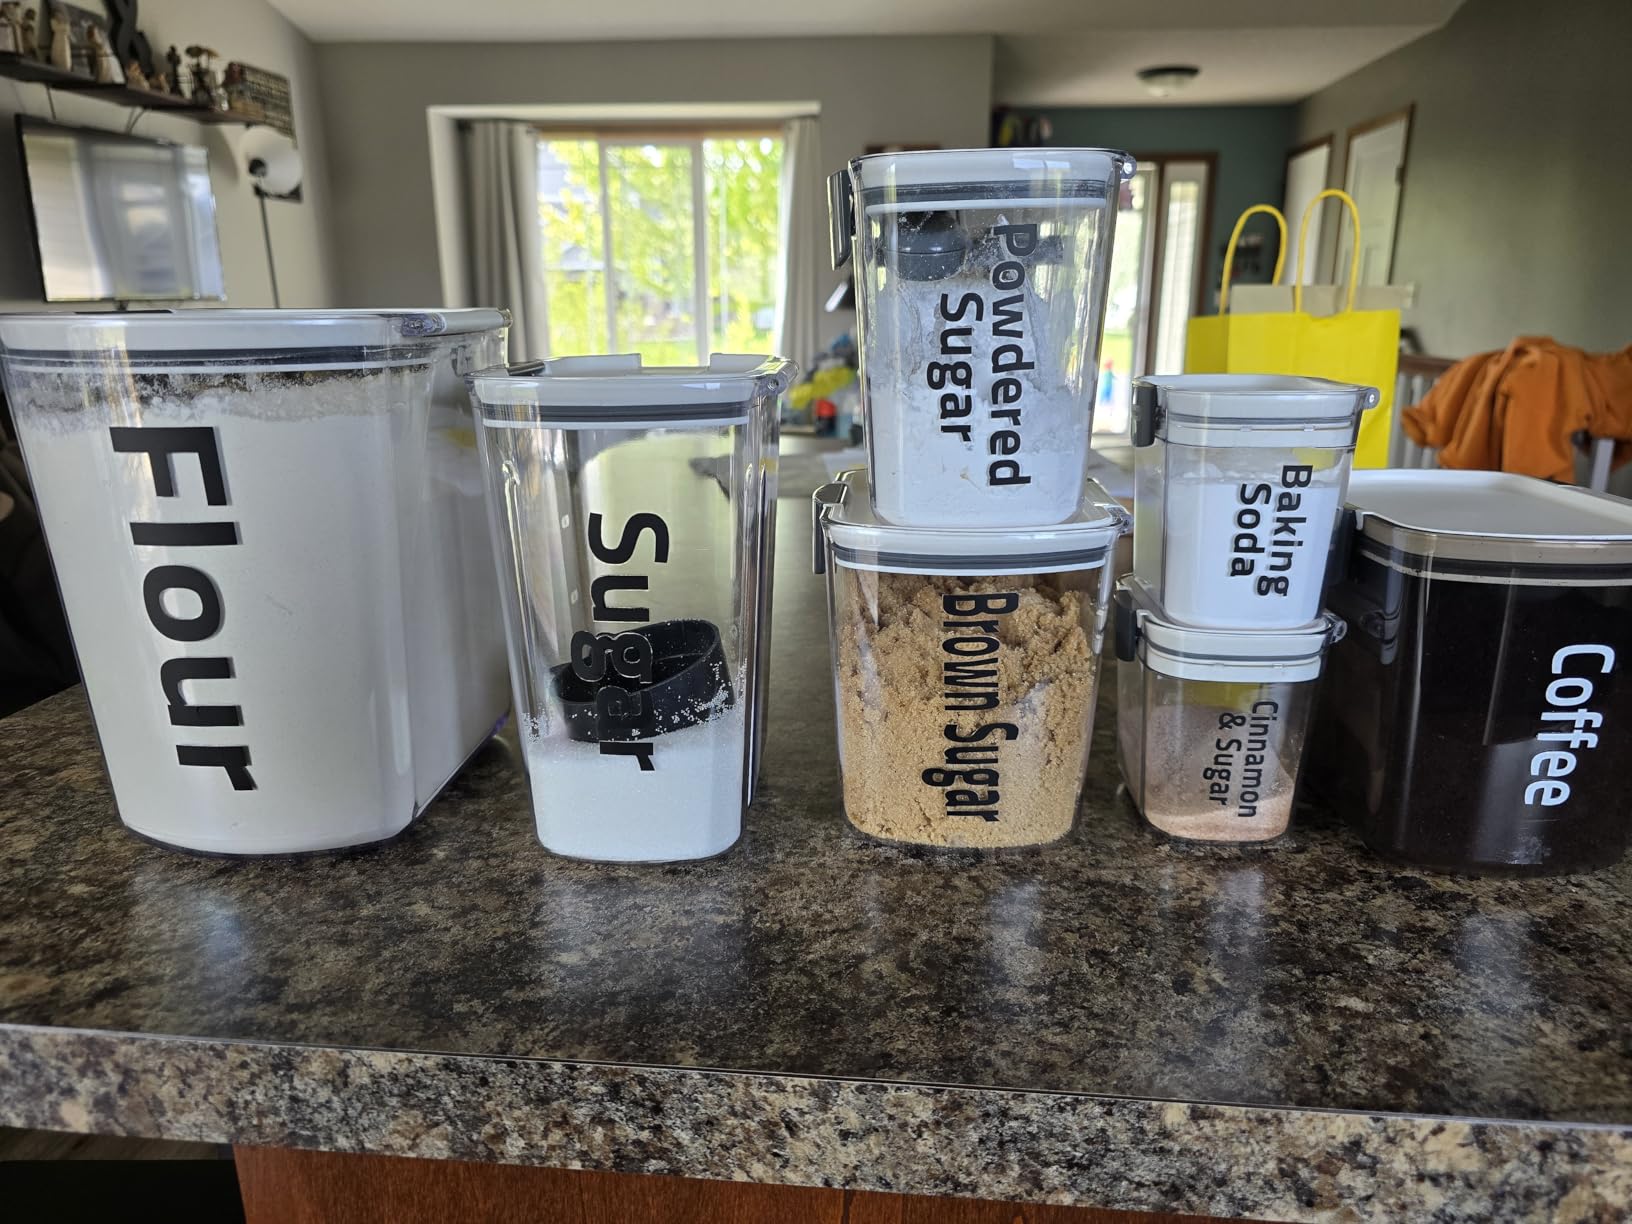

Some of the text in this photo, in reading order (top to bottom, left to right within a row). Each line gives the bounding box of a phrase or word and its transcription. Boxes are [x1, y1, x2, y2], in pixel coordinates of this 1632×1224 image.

[926, 292, 984, 443] Sugar
[989, 223, 1038, 487] Powdered
[110, 426, 257, 791] Flour
[1229, 483, 1272, 577] Soda
[1256, 464, 1313, 597] Baking
[570, 512, 671, 772] Sugar
[921, 592, 1020, 822] Brown Sugar
[1203, 712, 1247, 806] & Sugar
[1238, 701, 1279, 817] Cinnamon
[1524, 644, 1616, 807] Coffee
